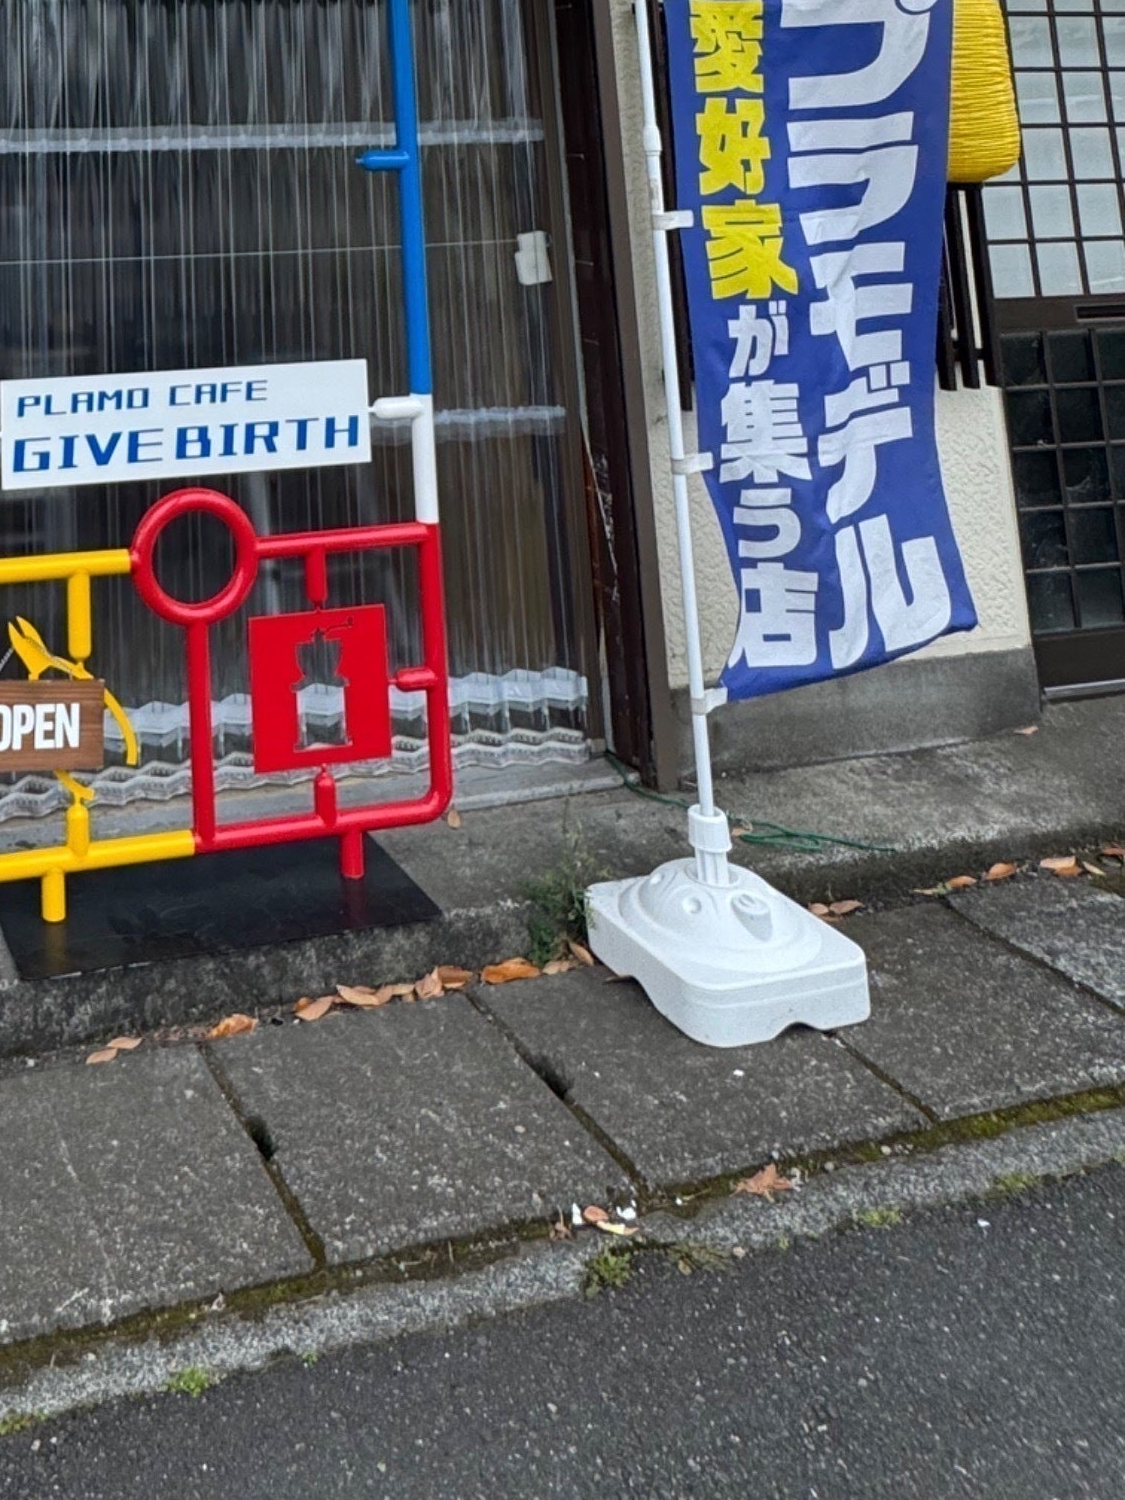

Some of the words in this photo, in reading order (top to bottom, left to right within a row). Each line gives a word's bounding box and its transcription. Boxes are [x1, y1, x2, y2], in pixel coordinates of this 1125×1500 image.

[17, 387, 150, 418] PLAMO
[169, 379, 269, 407] CAFE
[12, 427, 164, 474] GIVE
[175, 414, 360, 461] BIRTH
